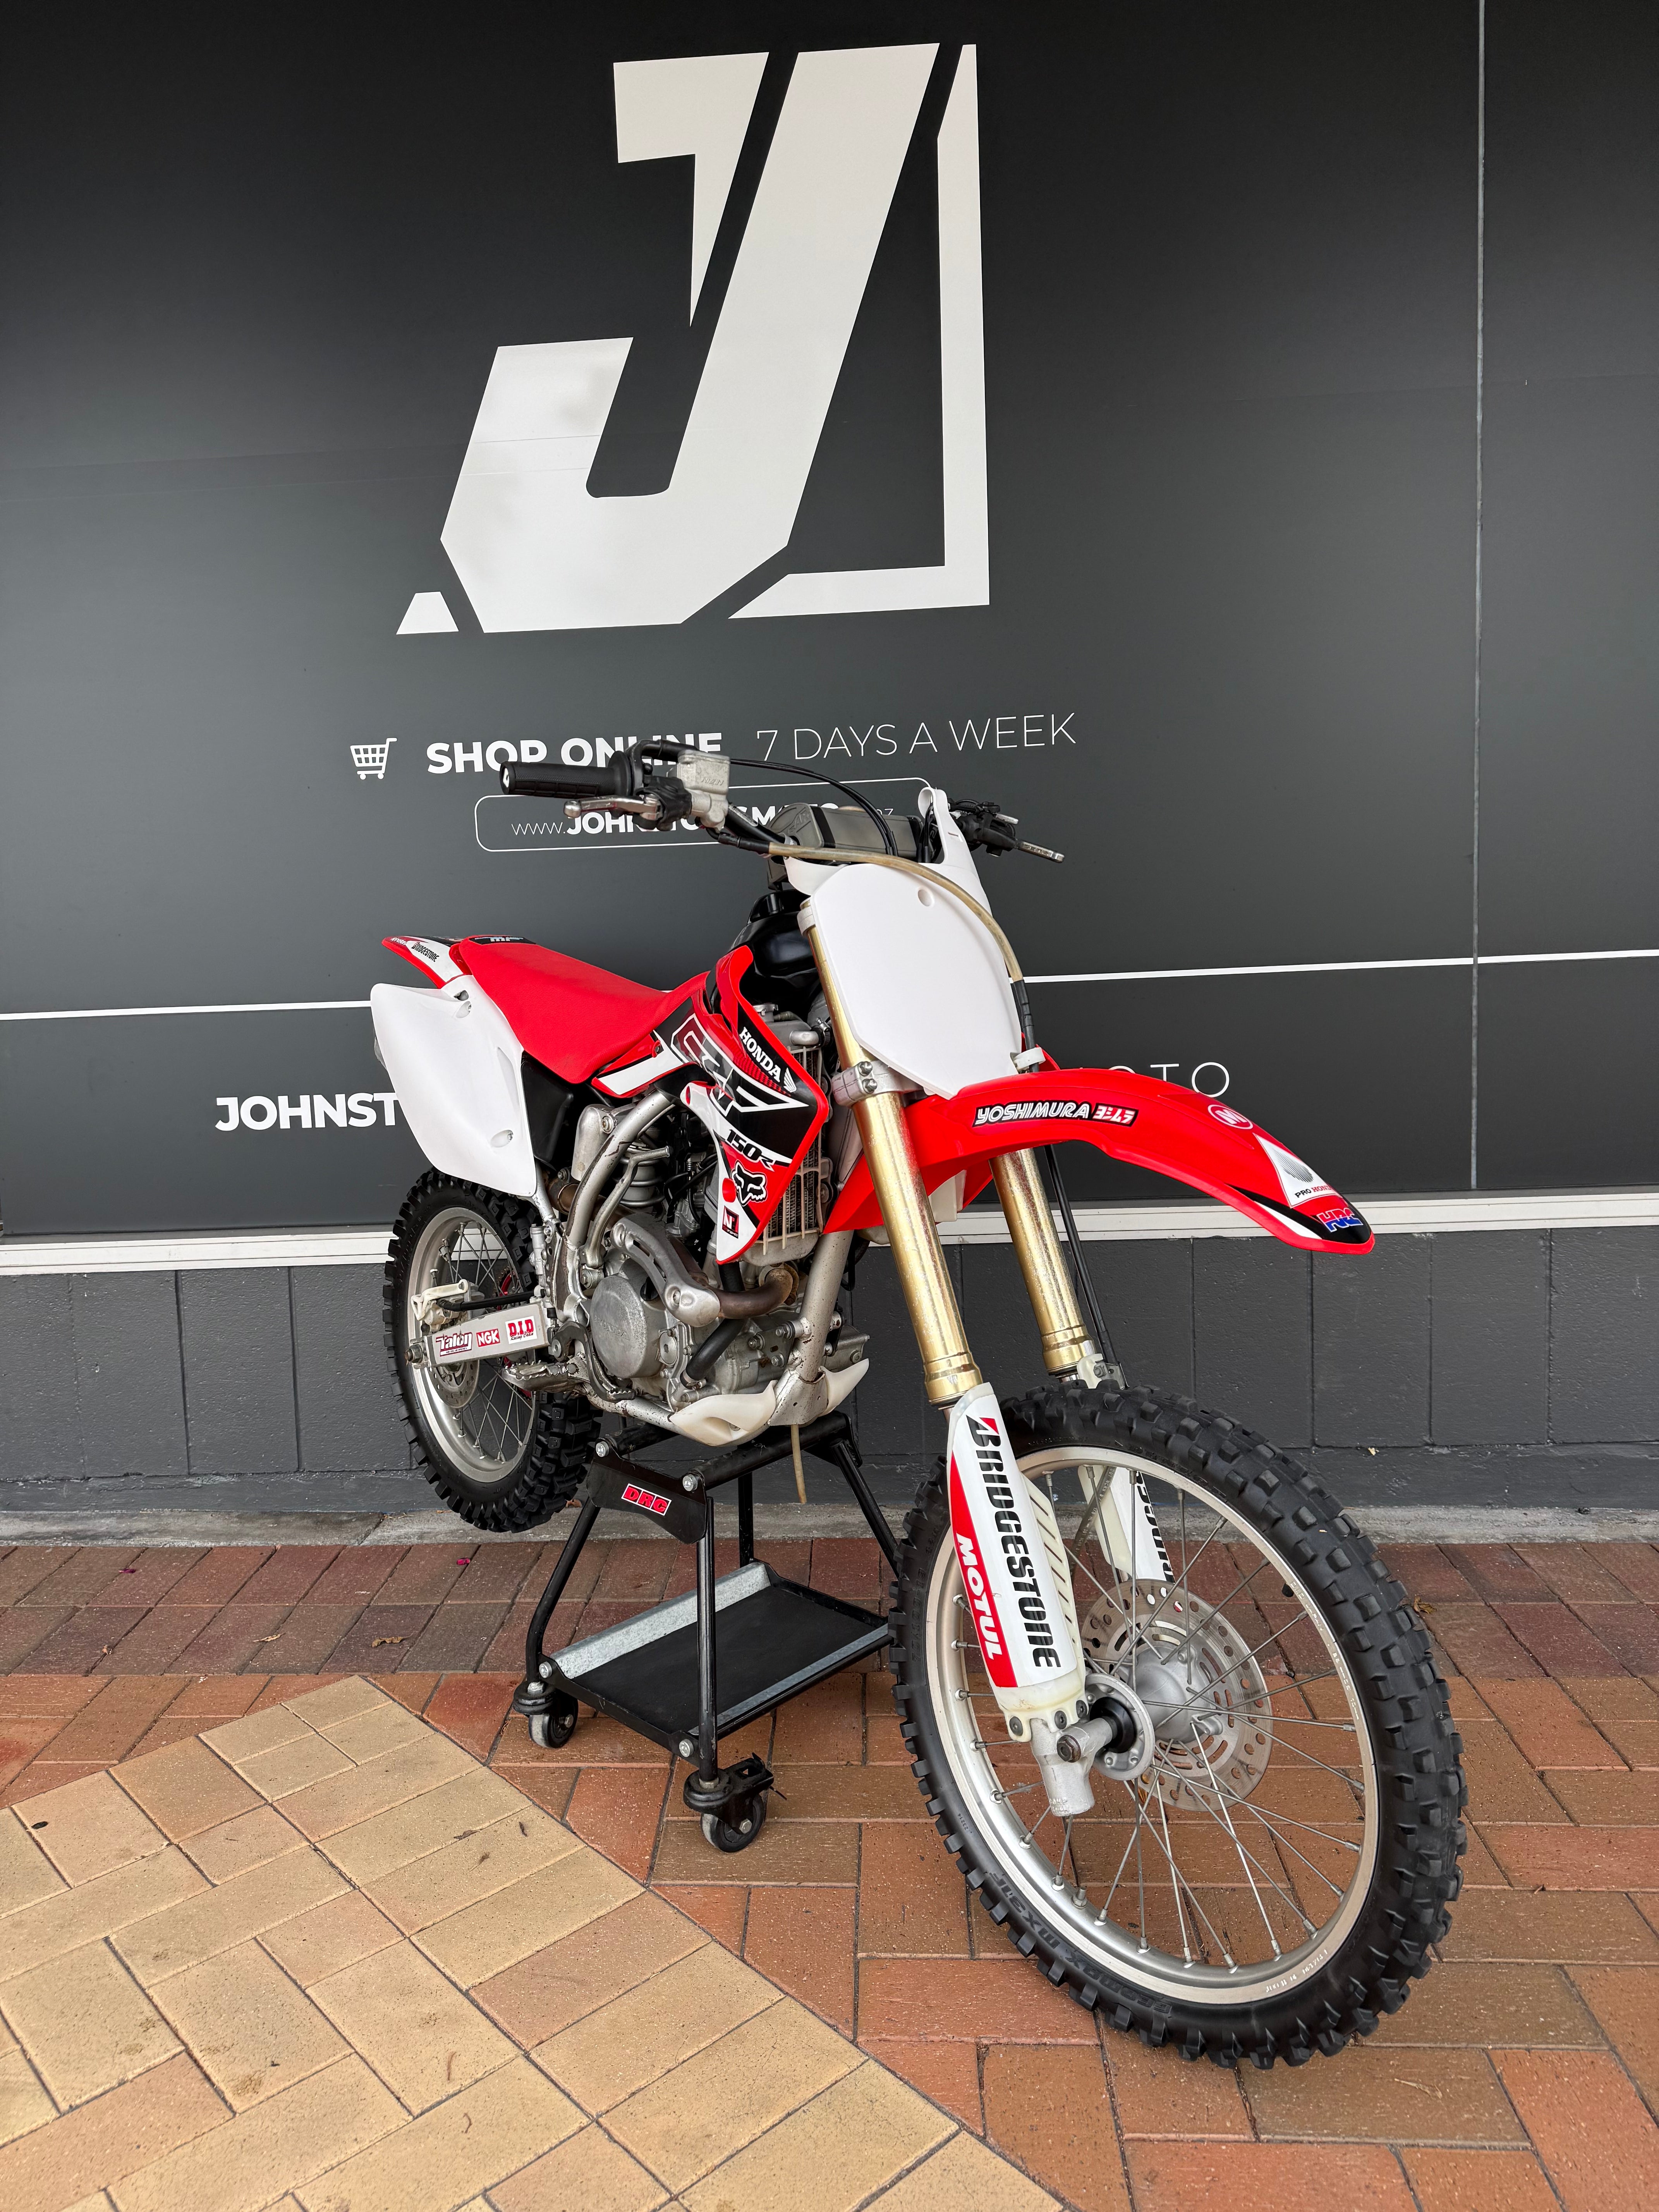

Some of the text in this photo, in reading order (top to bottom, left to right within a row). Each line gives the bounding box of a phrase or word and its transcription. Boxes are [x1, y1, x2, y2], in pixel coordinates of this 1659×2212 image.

[427, 740, 547, 774] SHOP
[757, 730, 778, 761] 7
[794, 724, 897, 760] DAYS
[909, 722, 938, 754] A
[948, 712, 1076, 751] WEEK
[411, 942, 440, 962] BRIDGESTONE
[739, 1026, 781, 1082] HONDA
[215, 1092, 399, 1132] JOHNST
[975, 1102, 1090, 1125] YOSHIMURA
[1295, 1188, 1312, 1198] PRO
[477, 1329, 500, 1346] NGK
[508, 1319, 534, 1337] D.I.D
[436, 1332, 472, 1350] Talon
[624, 1487, 667, 1512] DRC
[966, 1415, 1061, 1668] BRIDGESTONE
[955, 1533, 1002, 1660] MOTUL
